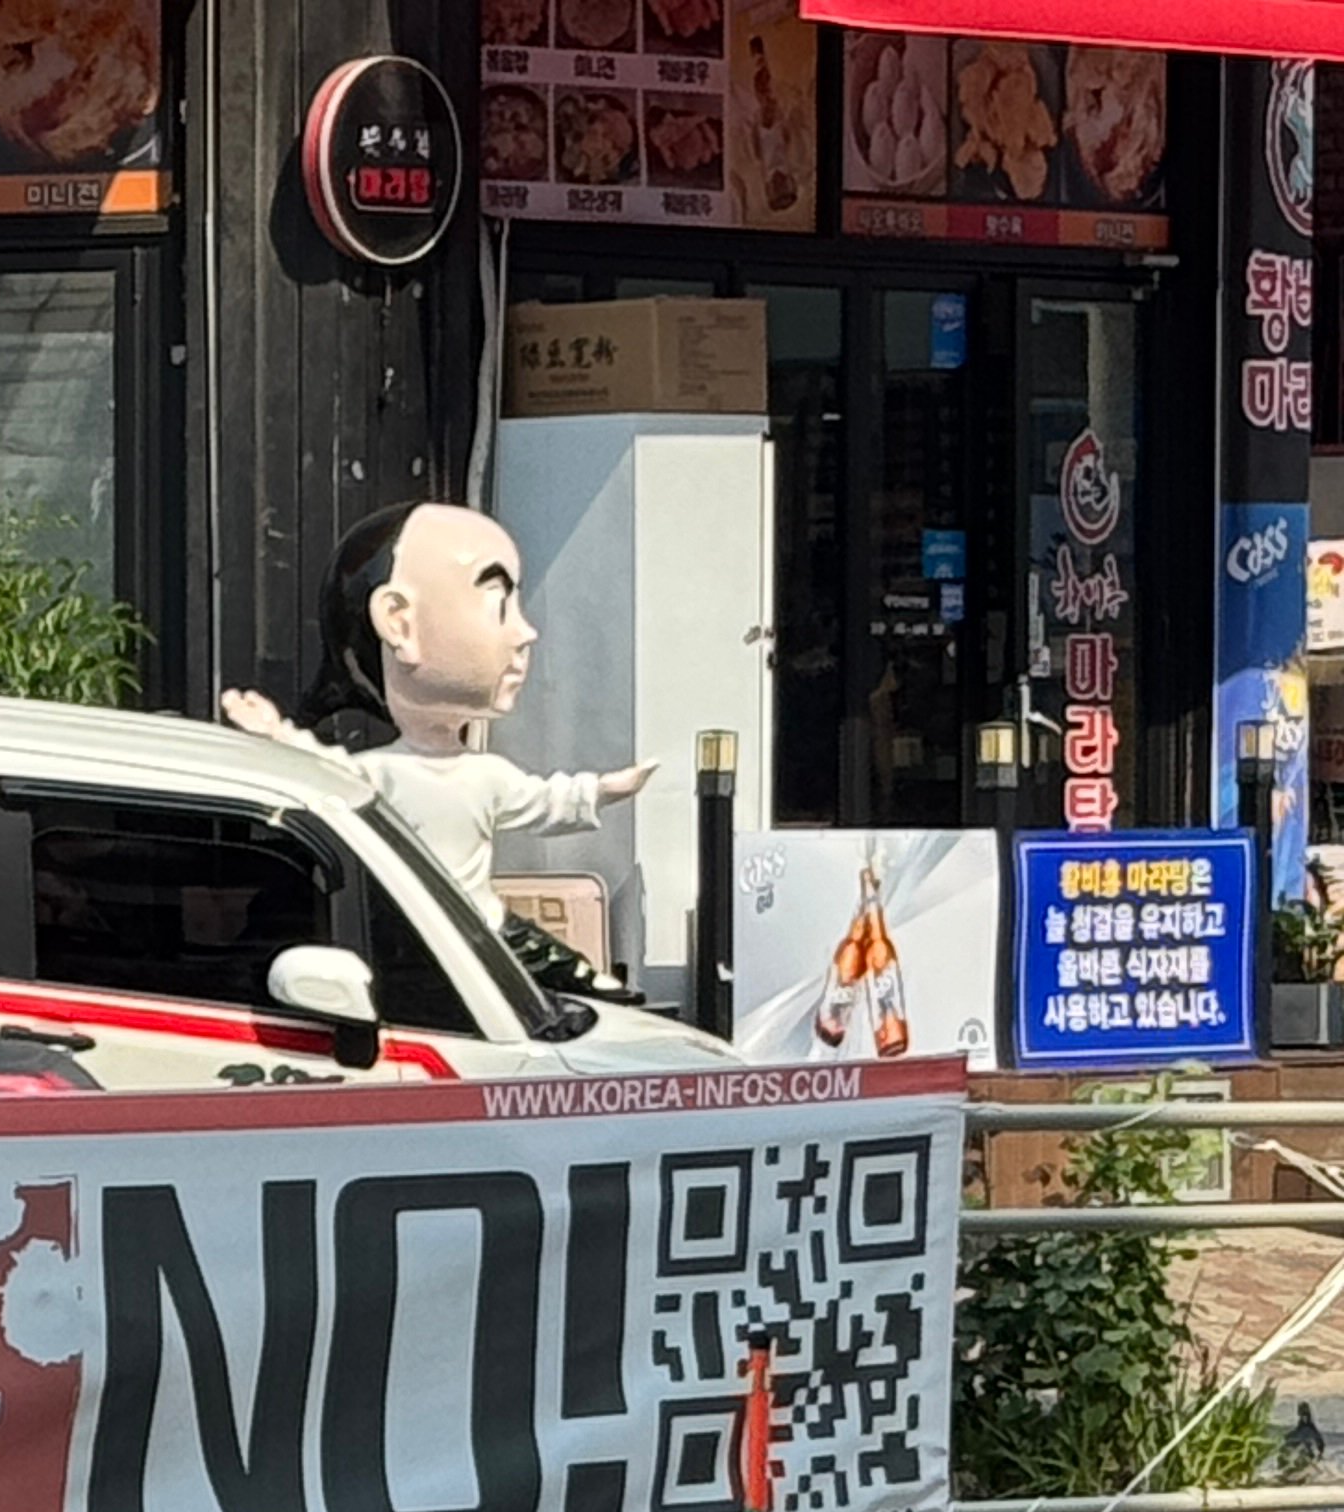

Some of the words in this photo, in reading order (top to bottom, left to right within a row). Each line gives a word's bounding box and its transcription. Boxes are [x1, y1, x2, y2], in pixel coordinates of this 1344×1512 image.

[1139, 902, 1227, 940] 유지하고
[1044, 993, 1133, 1034] 사용하고
[481, 1066, 862, 1119] WWW.KOREA-INFOS.COM
